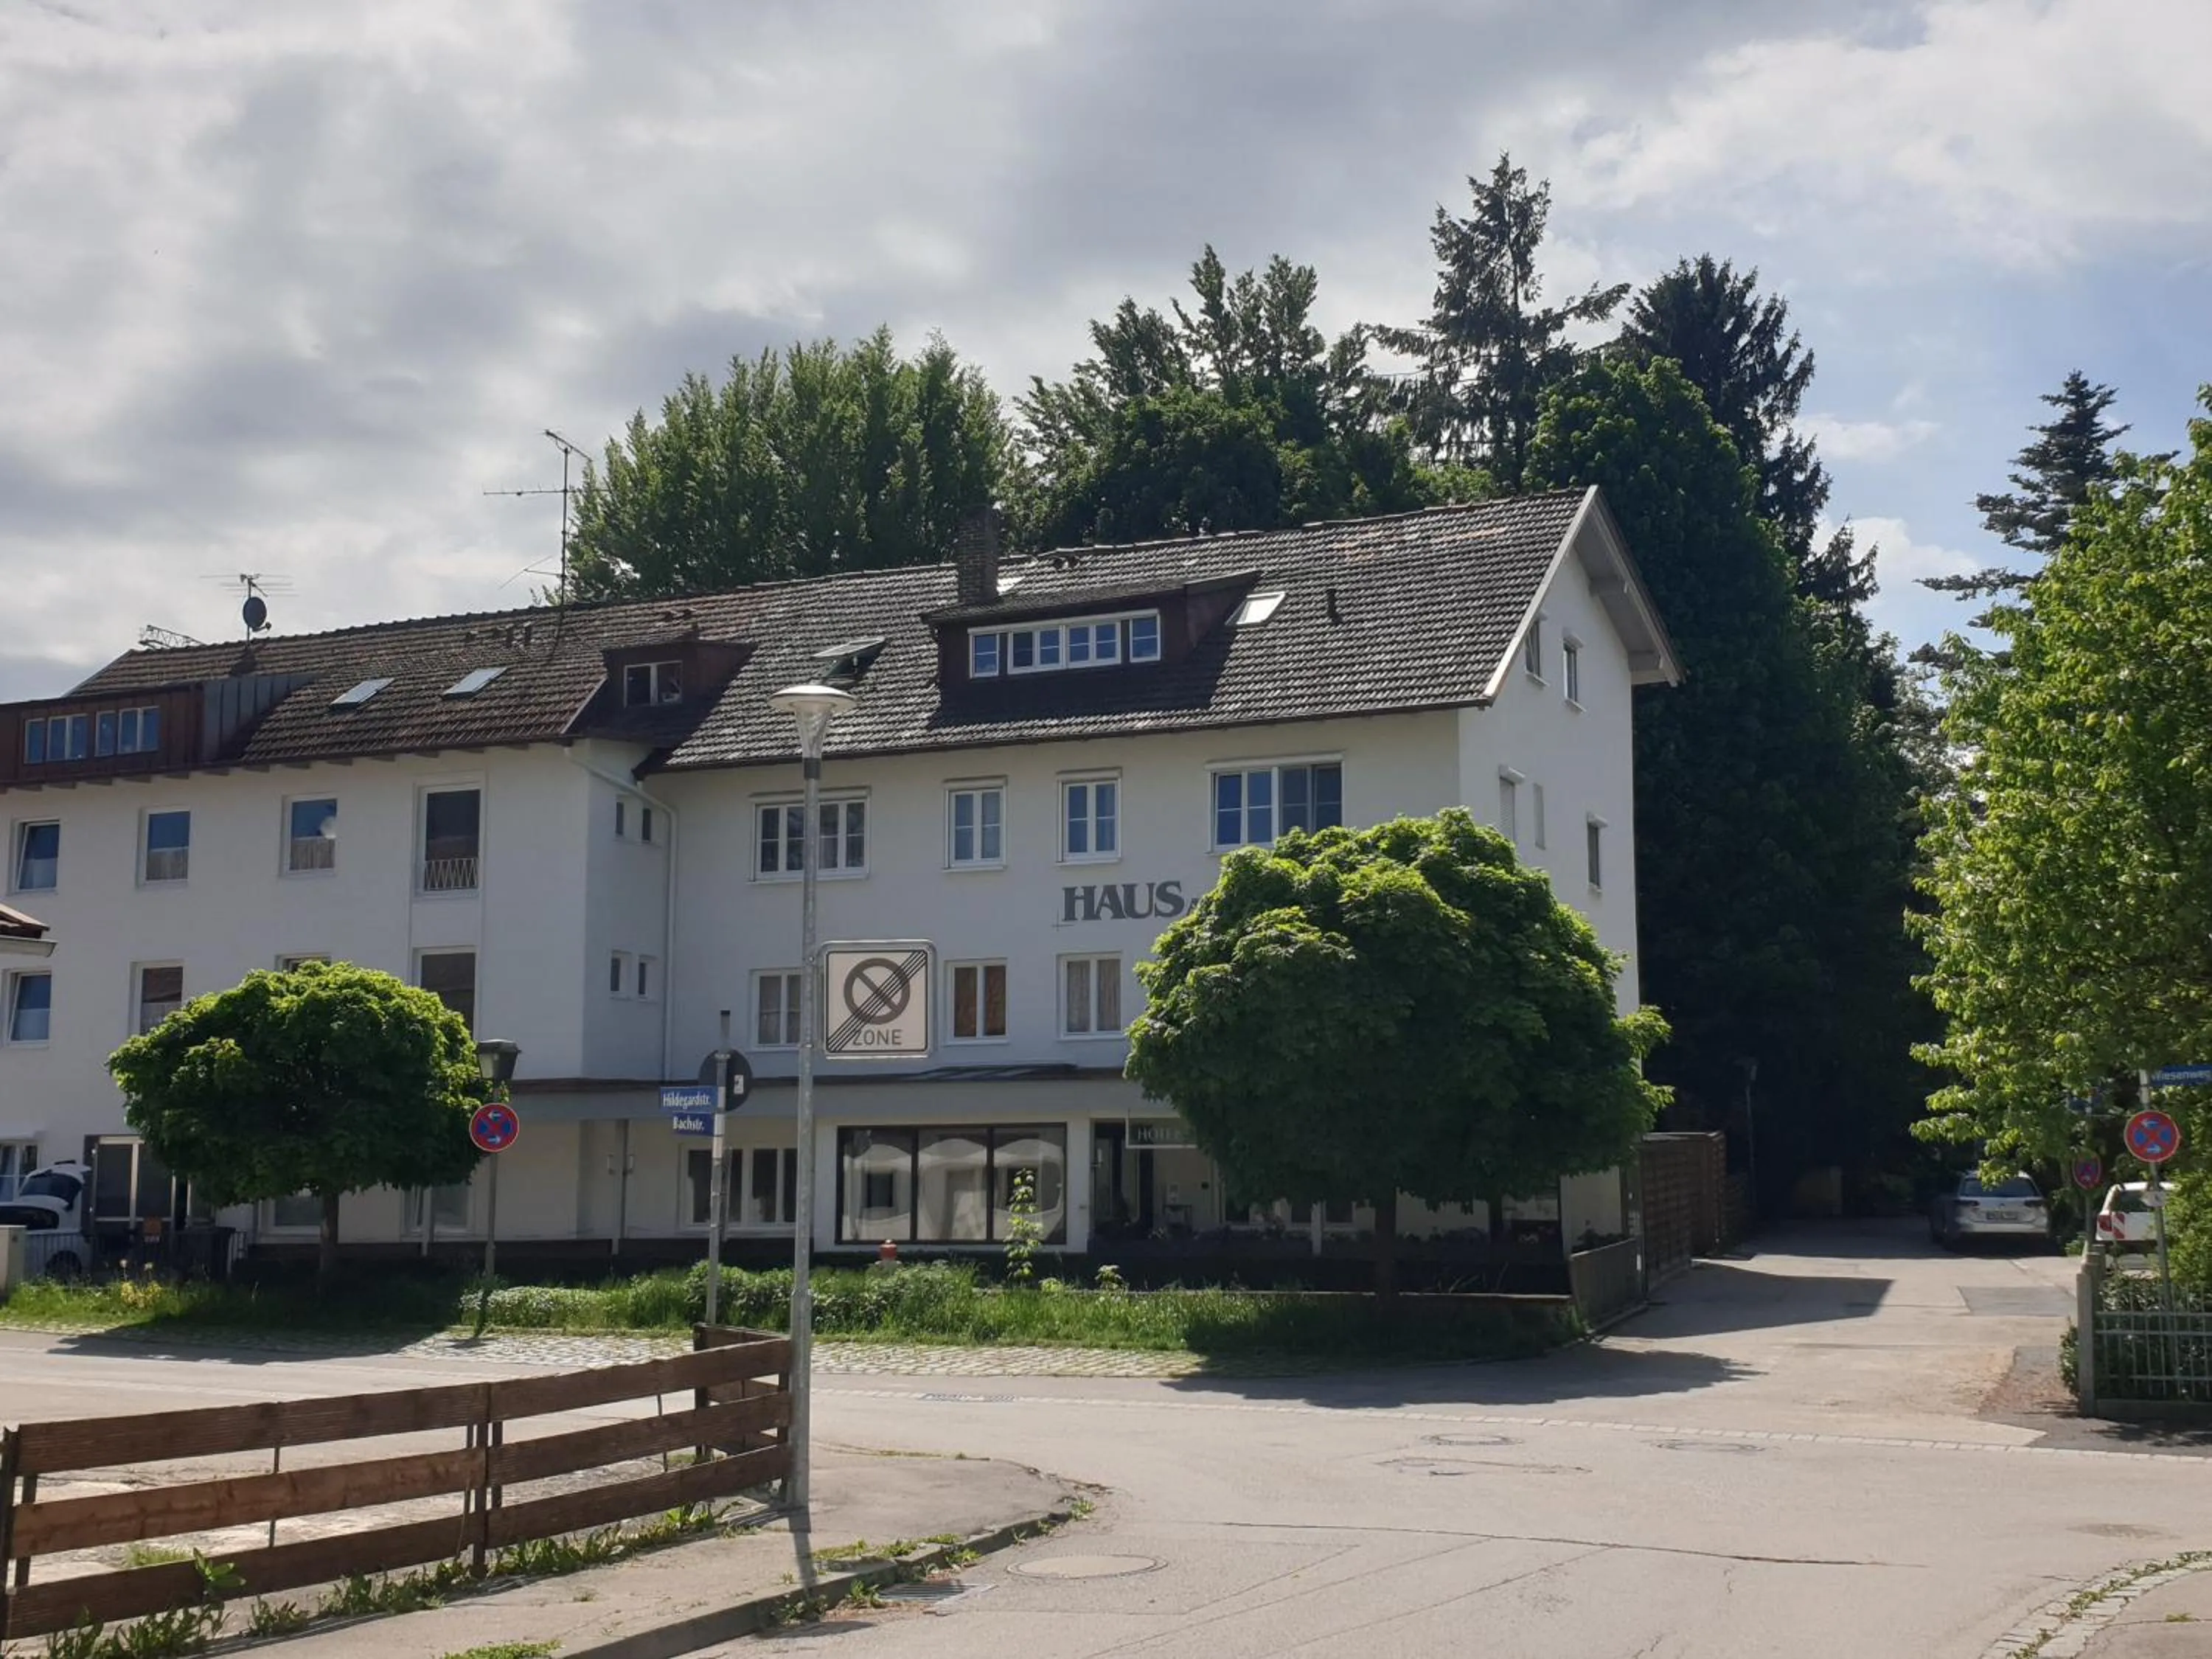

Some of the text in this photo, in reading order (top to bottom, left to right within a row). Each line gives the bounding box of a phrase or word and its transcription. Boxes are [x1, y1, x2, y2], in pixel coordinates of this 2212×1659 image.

[1062, 880, 1185, 922] HAUS
[852, 1029, 903, 1046] ZONE
[663, 1091, 712, 1109] Hildegardstr.
[672, 1115, 706, 1133] Bachstr.
